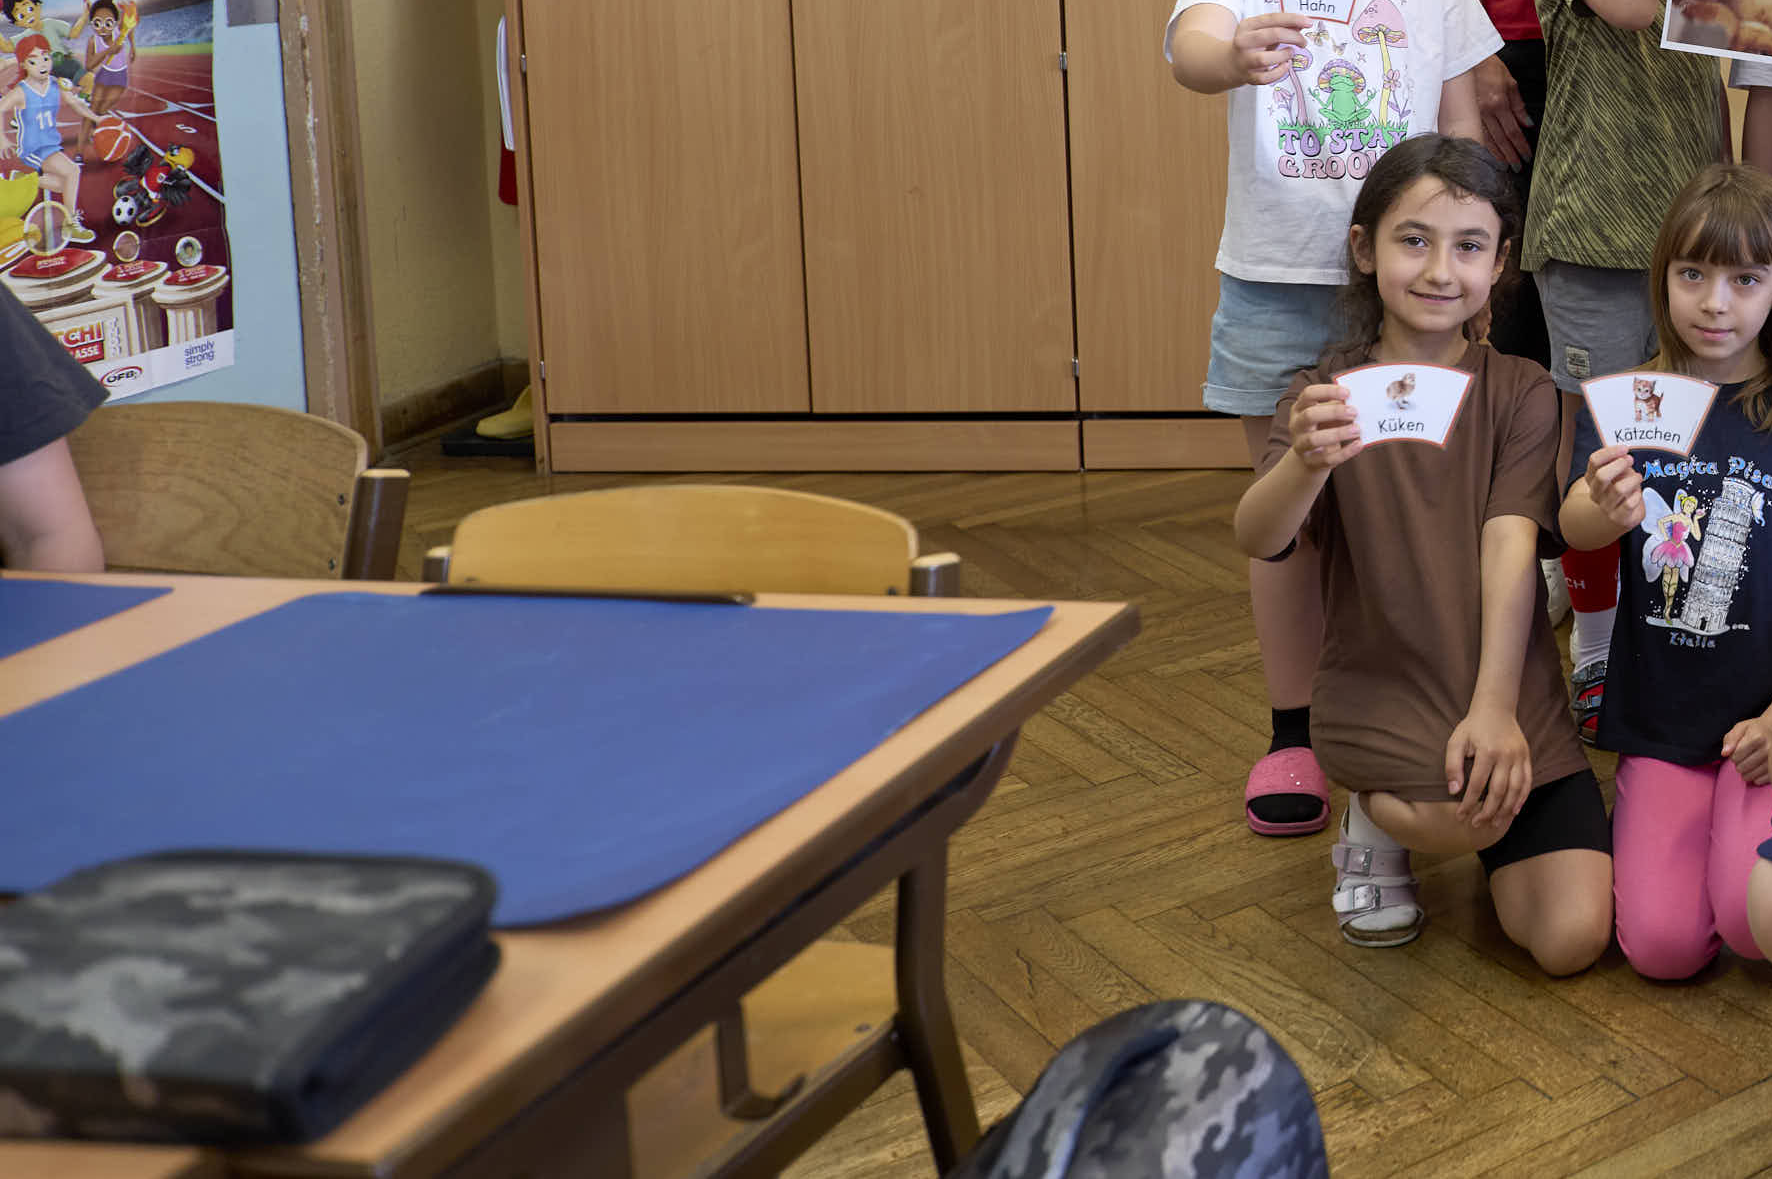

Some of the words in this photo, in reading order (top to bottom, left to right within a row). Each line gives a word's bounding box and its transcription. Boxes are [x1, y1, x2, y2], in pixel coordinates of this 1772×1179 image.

[36, 109, 54, 129] 11
[1278, 128, 1321, 157] TO
[1328, 128, 1408, 155] STAY
[184, 339, 215, 357] simply
[184, 350, 215, 367] strong
[1377, 417, 1425, 434] Küken
[1613, 426, 1681, 445] Kätzchen
[1642, 453, 1720, 481] Magica
